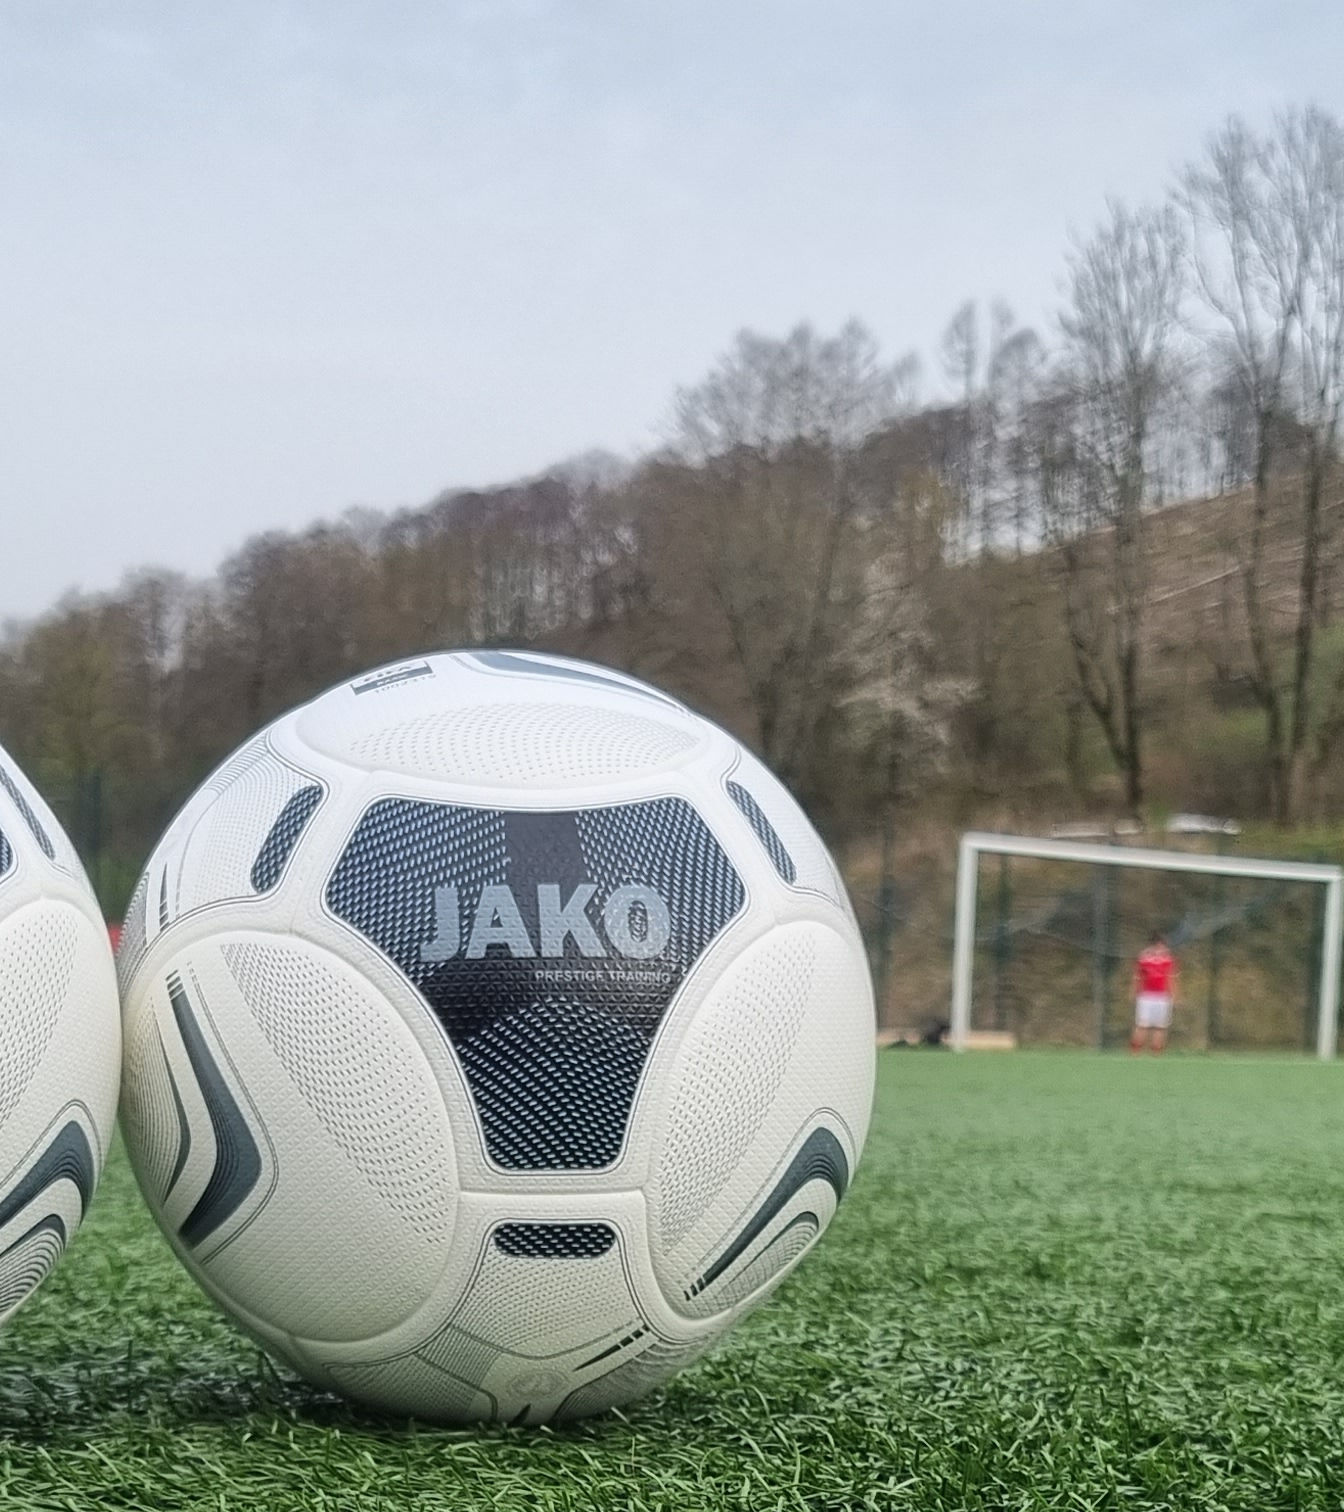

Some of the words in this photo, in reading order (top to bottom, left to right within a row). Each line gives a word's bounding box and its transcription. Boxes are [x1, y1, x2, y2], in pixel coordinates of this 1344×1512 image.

[419, 884, 672, 962] JAKO
[534, 970, 605, 983] PRESTIGE
[607, 970, 671, 984] TRAINING
